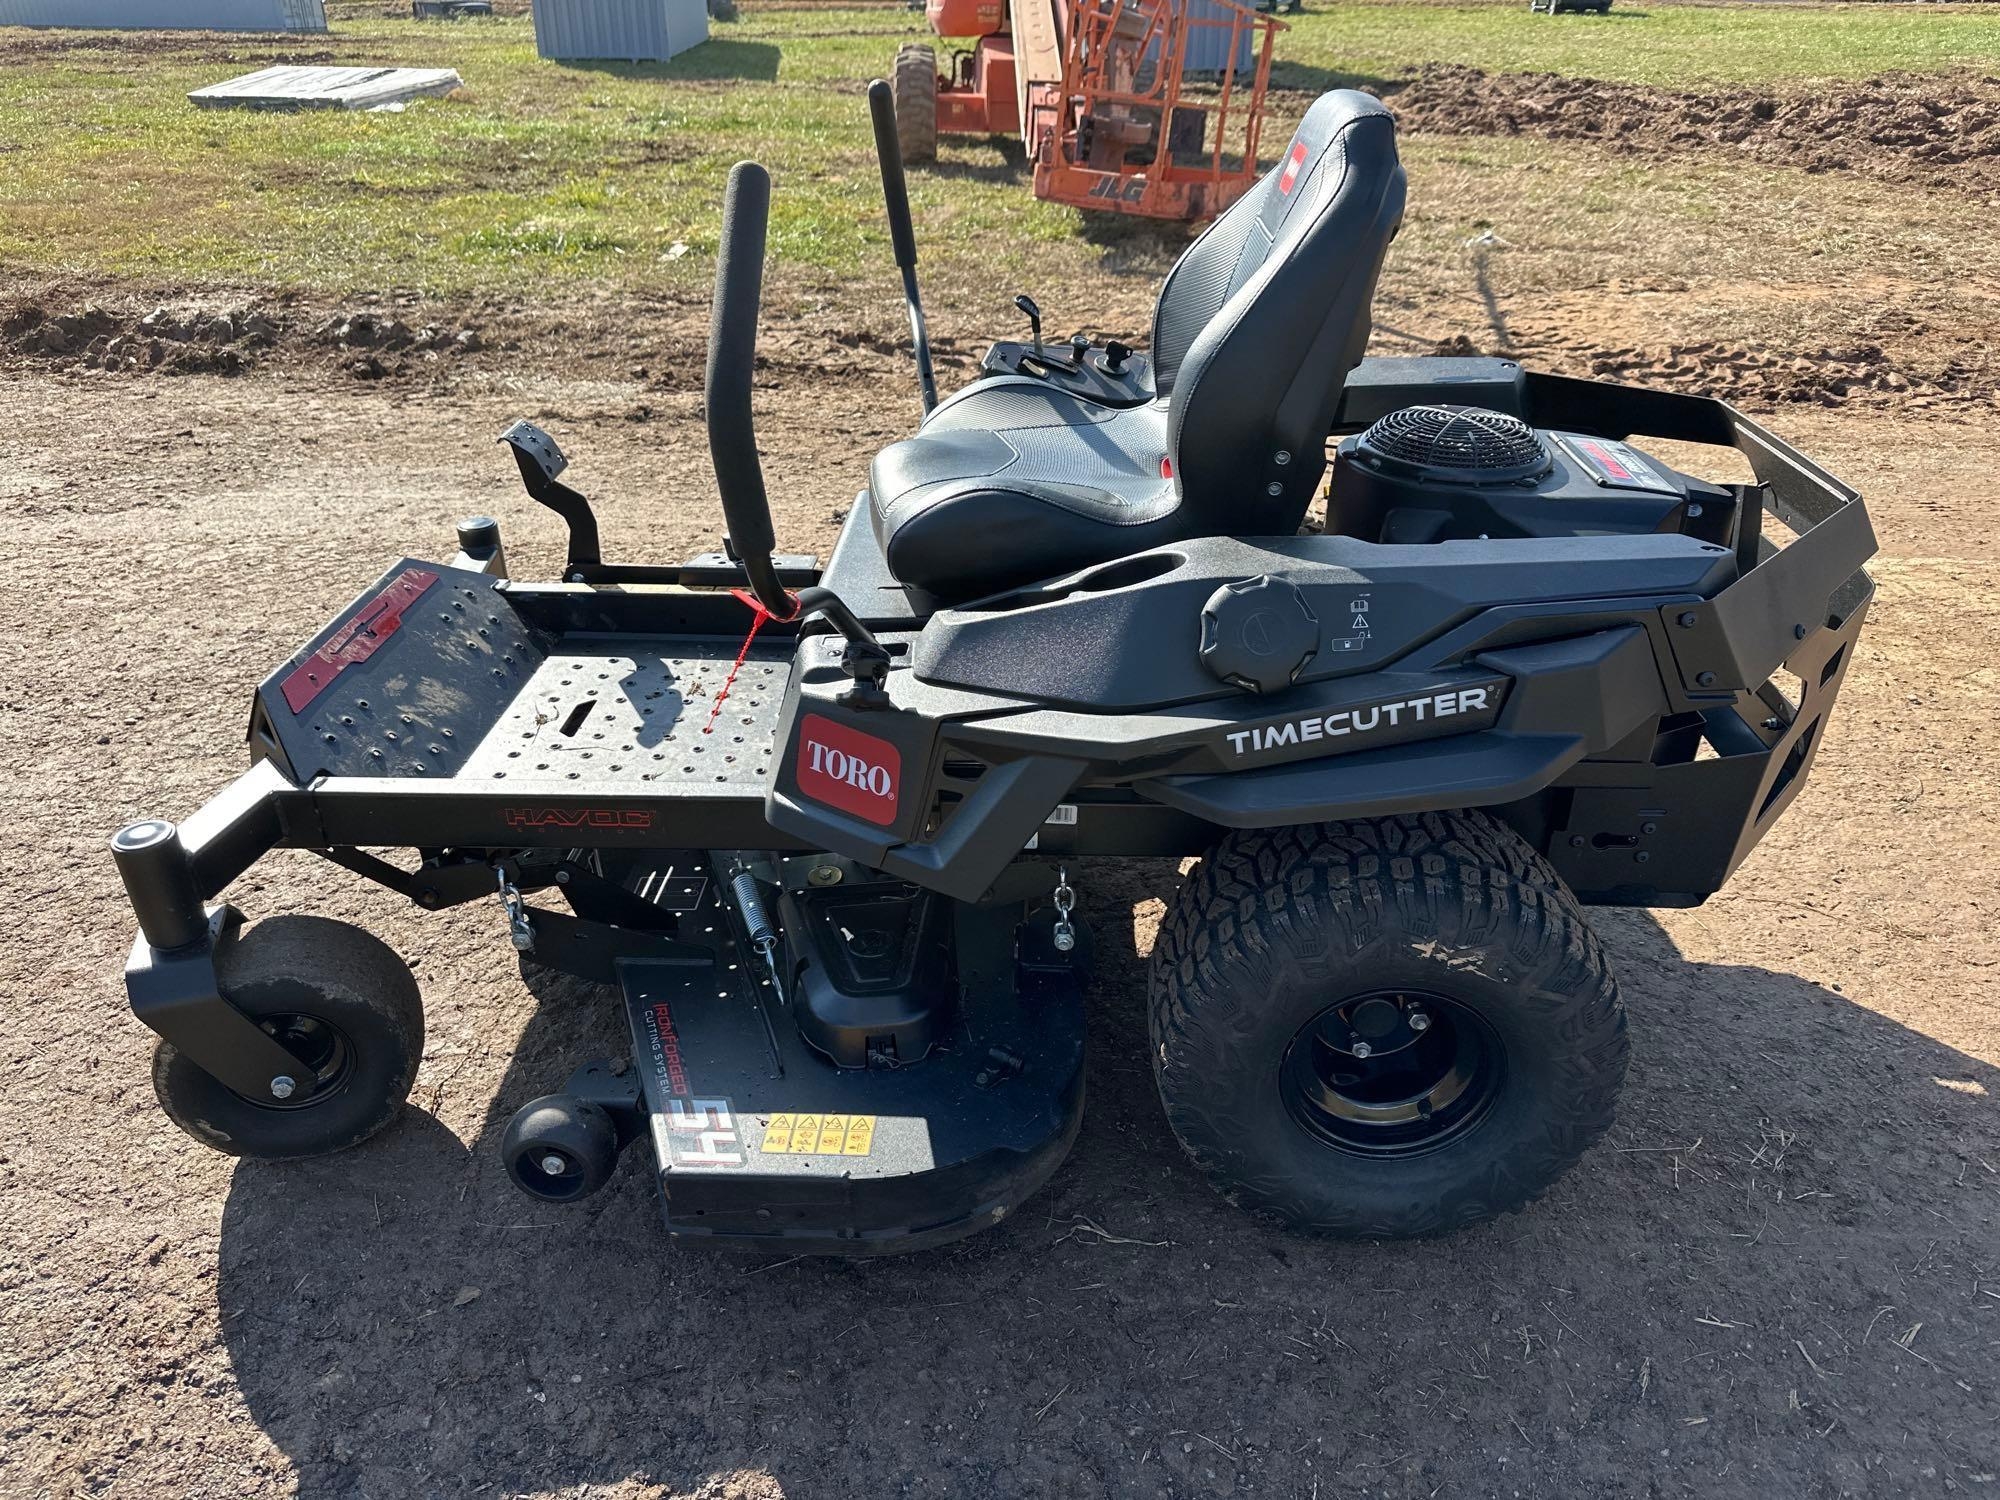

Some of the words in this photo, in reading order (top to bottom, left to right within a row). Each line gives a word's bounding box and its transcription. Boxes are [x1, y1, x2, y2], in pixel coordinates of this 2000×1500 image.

[1088, 175, 1149, 203] JLG
[1226, 688, 1489, 755] TIMECUTTER
[807, 740, 892, 797] TORO
[503, 809, 656, 827] HAVOC
[644, 1010, 662, 1051] CUTTING
[654, 1053, 671, 1095] SYSTEM
